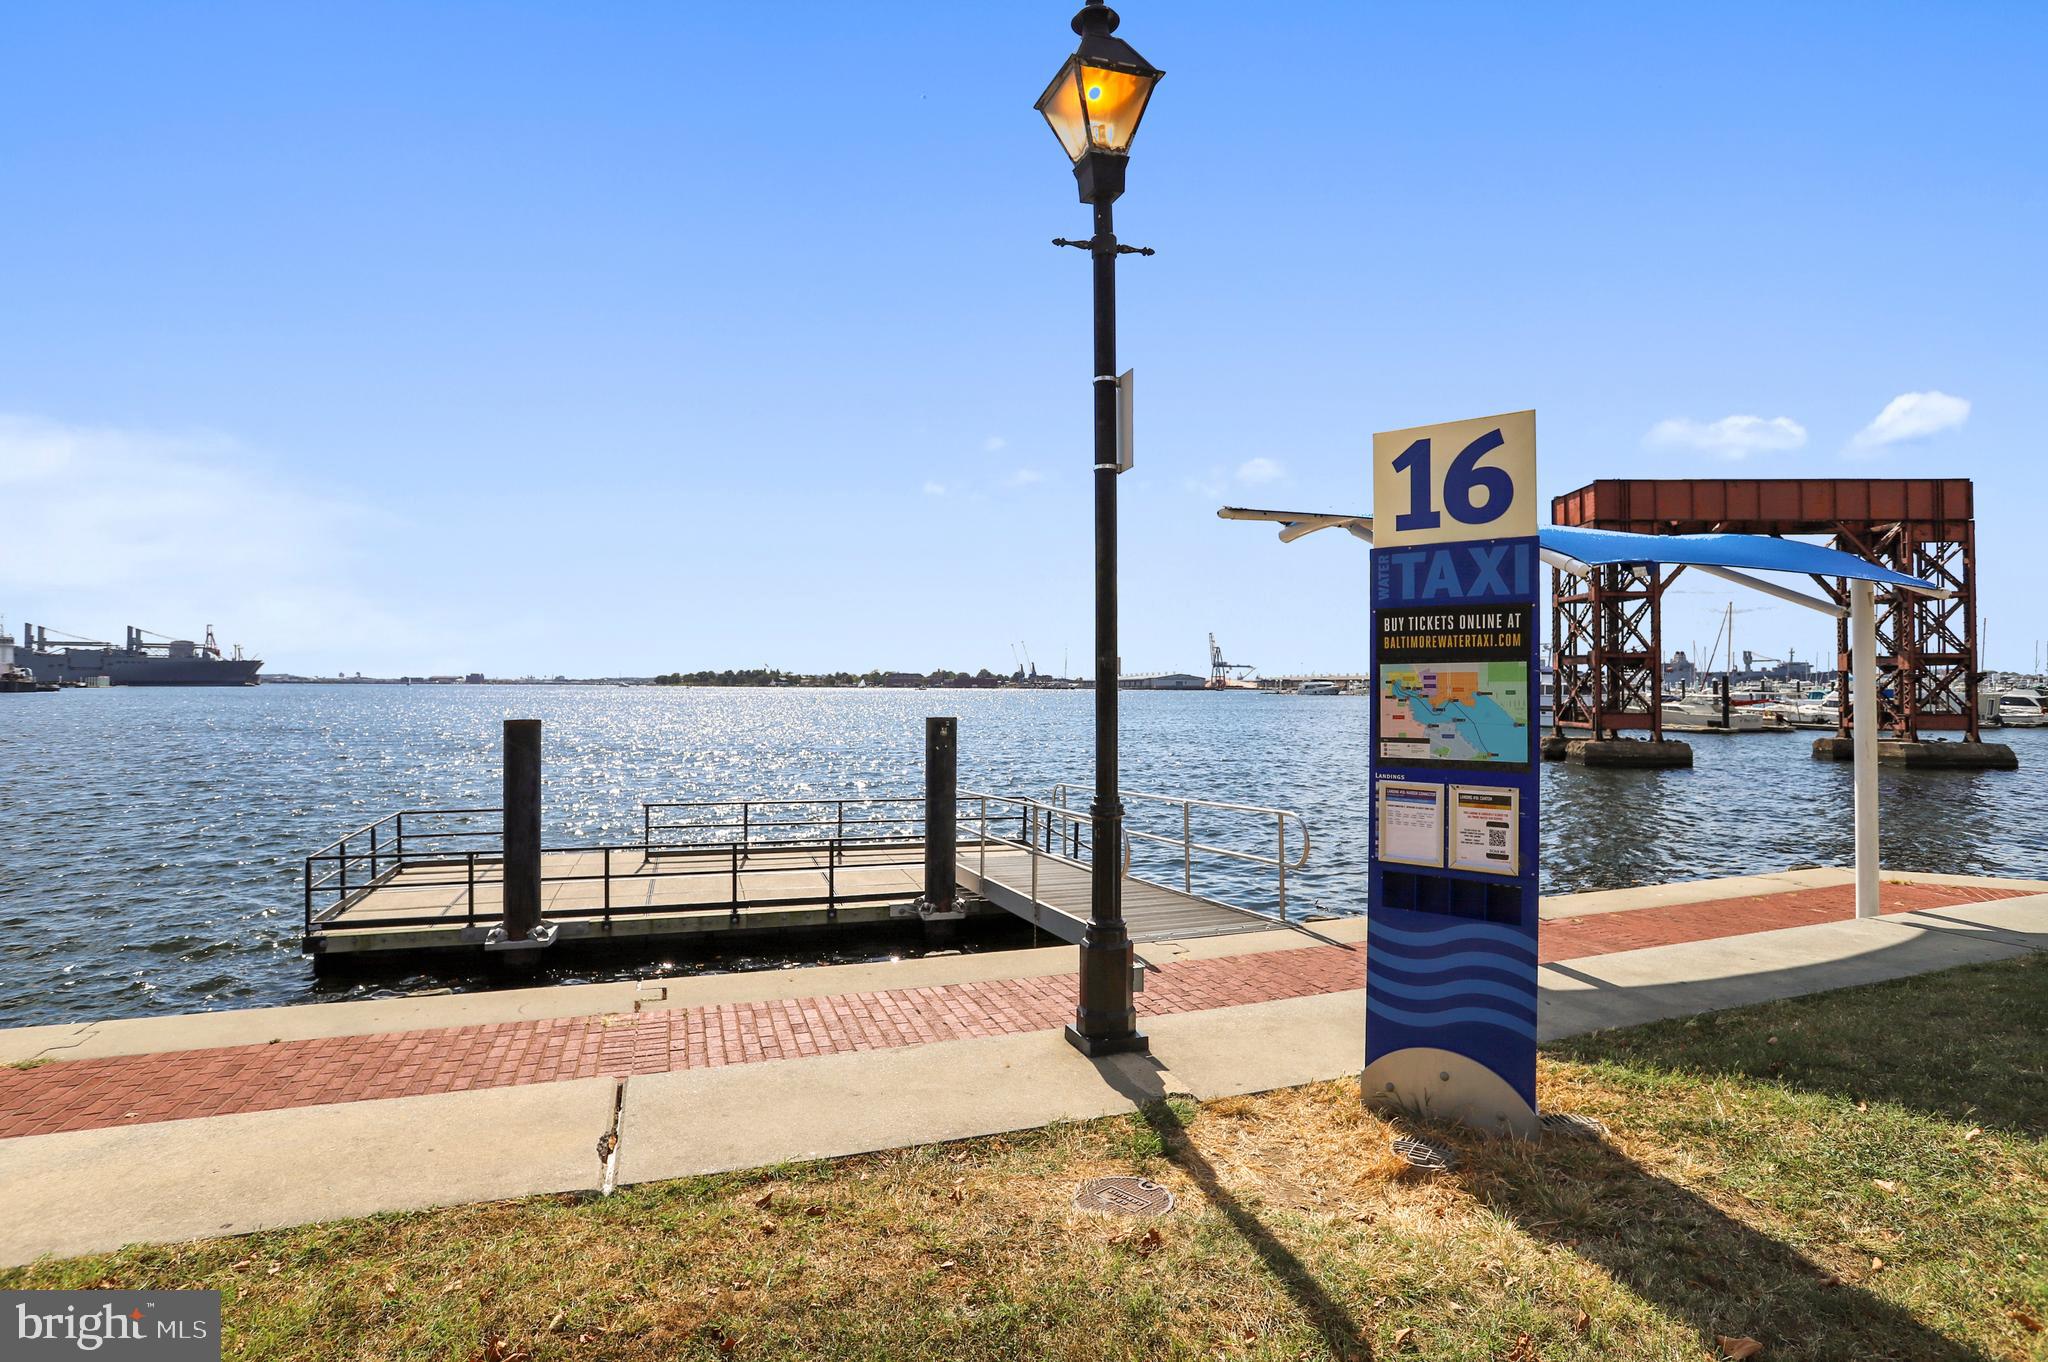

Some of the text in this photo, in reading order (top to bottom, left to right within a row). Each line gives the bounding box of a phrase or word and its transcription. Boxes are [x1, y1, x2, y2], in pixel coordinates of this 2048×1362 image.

[1391, 428, 1514, 531] 16
[1378, 554, 1390, 601] WATER
[1391, 544, 1530, 600] TAXI
[1384, 613, 1522, 632] BUY TICKETS ONLINE AT
[1384, 633, 1521, 650] BALTIMOREWATERTAXI.COM
